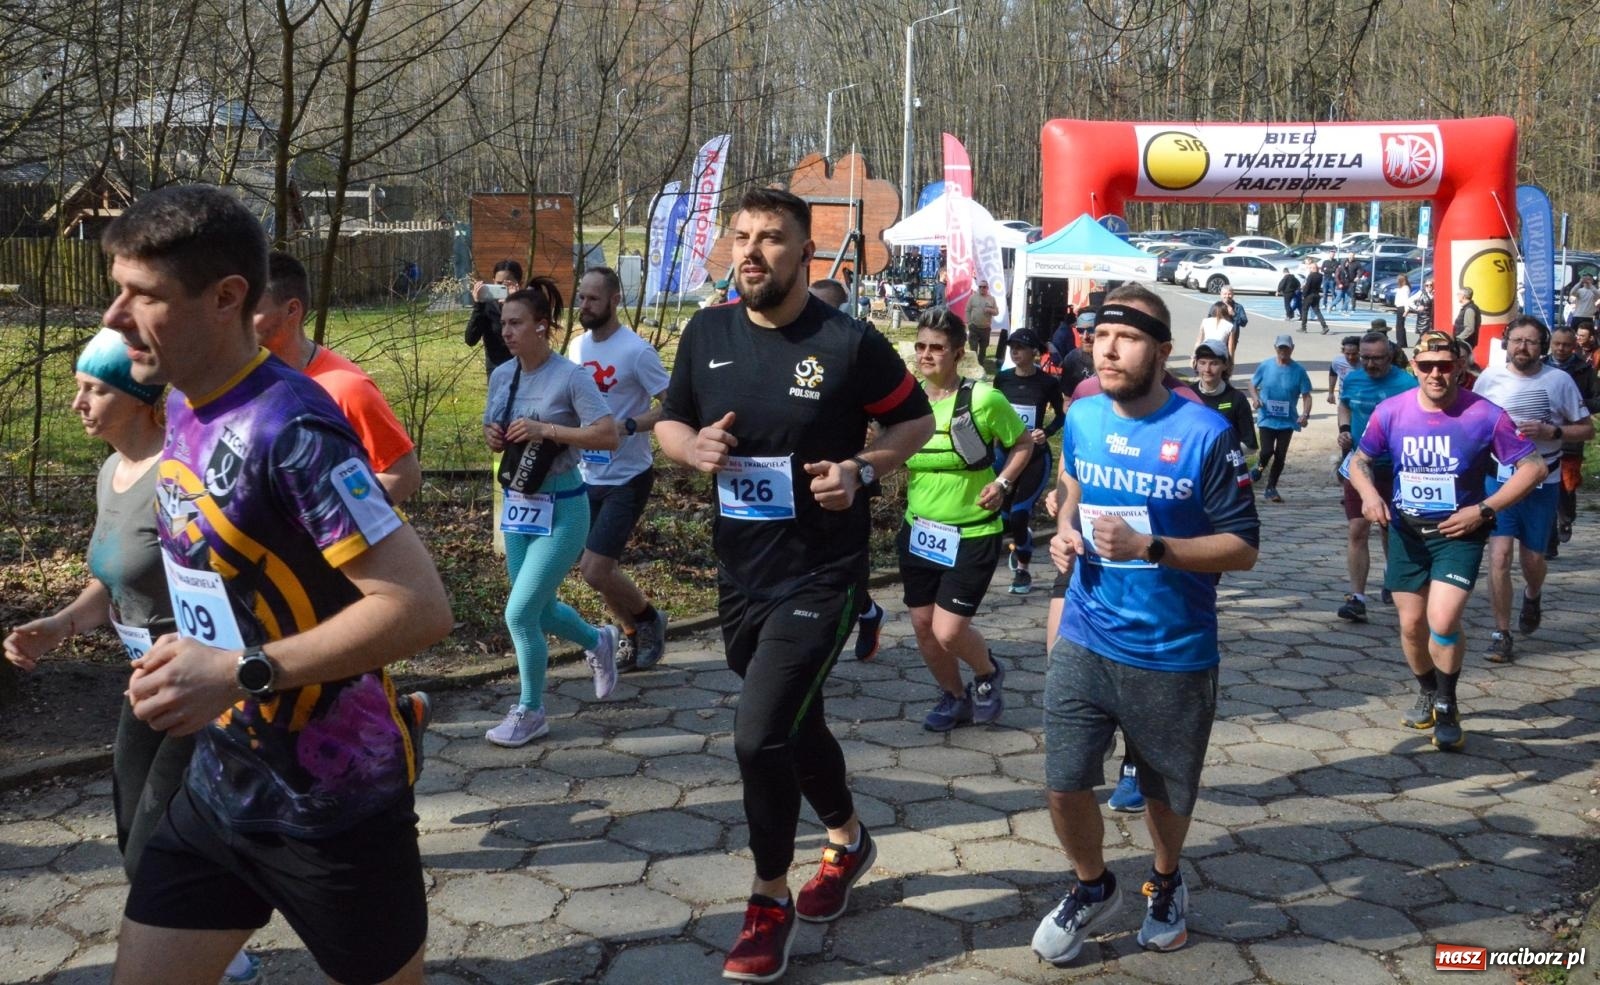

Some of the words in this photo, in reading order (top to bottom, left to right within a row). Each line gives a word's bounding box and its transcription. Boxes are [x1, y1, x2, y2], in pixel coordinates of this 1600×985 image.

[1265, 132, 1317, 145] BIEG
[1223, 153, 1364, 168] TWARDZIELA
[1235, 174, 1348, 190] RACIBÓRZ
[692, 150, 720, 260] RACIBÓRZ
[789, 387, 821, 400] POLSKA
[1402, 435, 1450, 468] RUN
[515, 440, 541, 489] adidas
[730, 478, 774, 503] 126
[1411, 486, 1442, 501] 091
[508, 505, 541, 523] 077
[917, 531, 947, 552] 034
